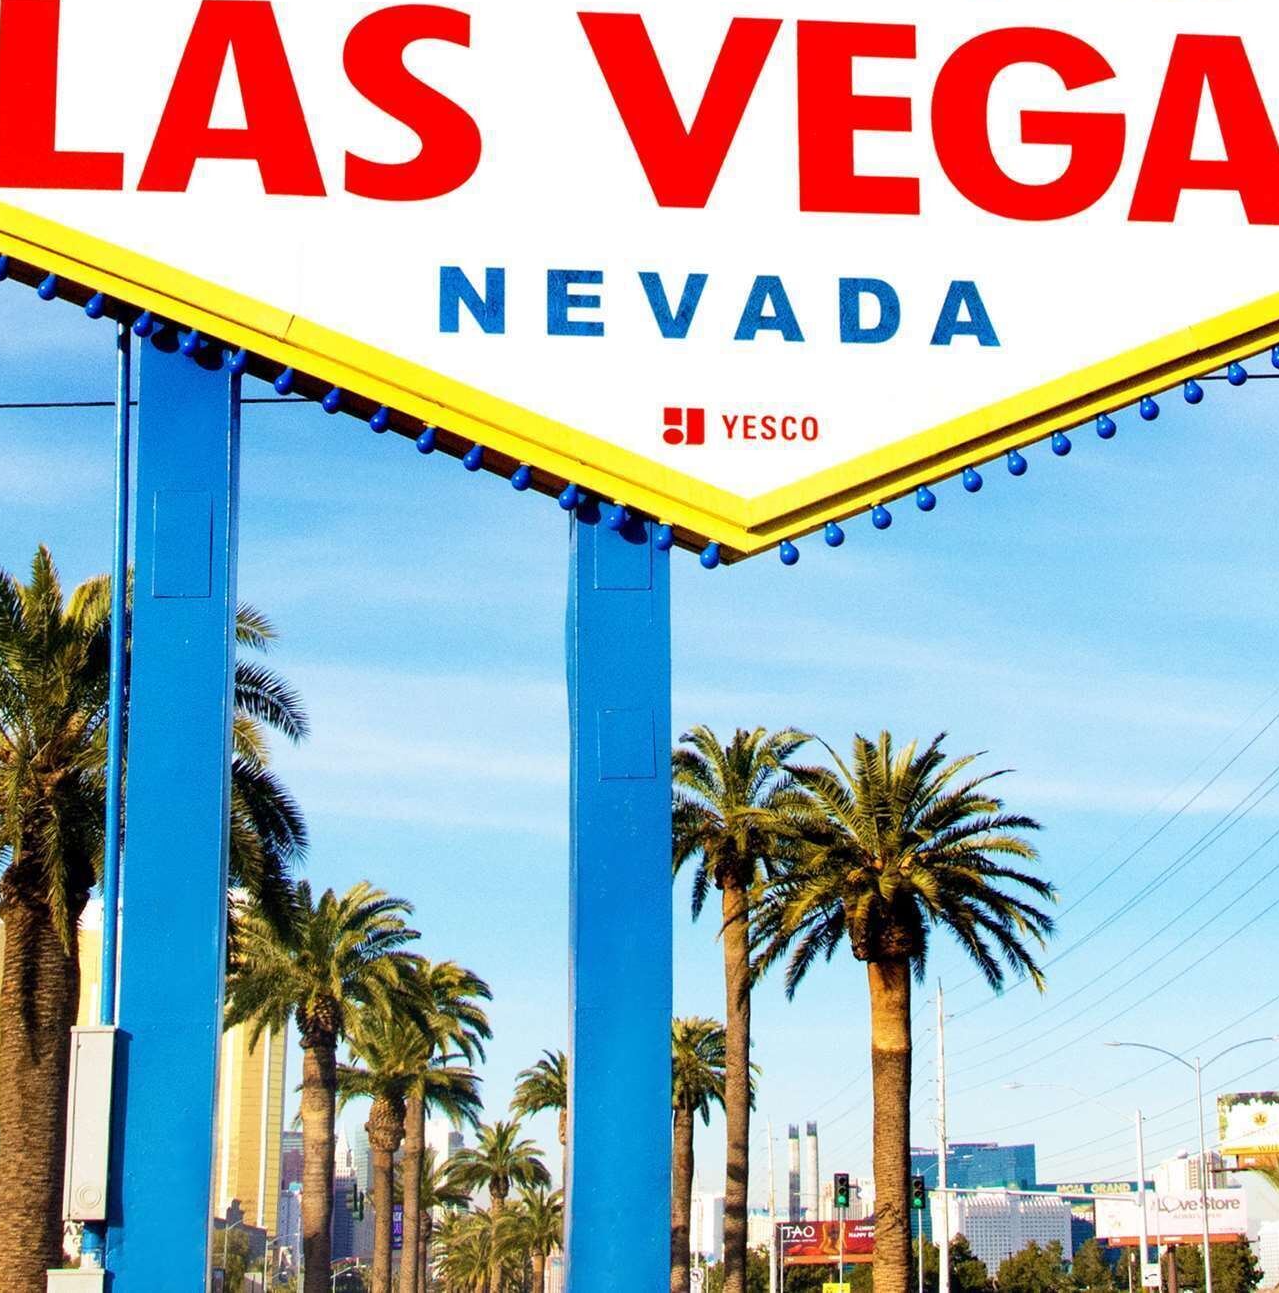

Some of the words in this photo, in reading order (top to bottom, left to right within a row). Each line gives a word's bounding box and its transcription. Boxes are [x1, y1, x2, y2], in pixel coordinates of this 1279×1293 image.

[438, 265, 1002, 348] NEVADA
[722, 414, 819, 442] YESCO
[1091, 1182, 1131, 1194] GRAND
[1200, 1195, 1240, 1210] Store
[782, 1225, 815, 1239] TAO
